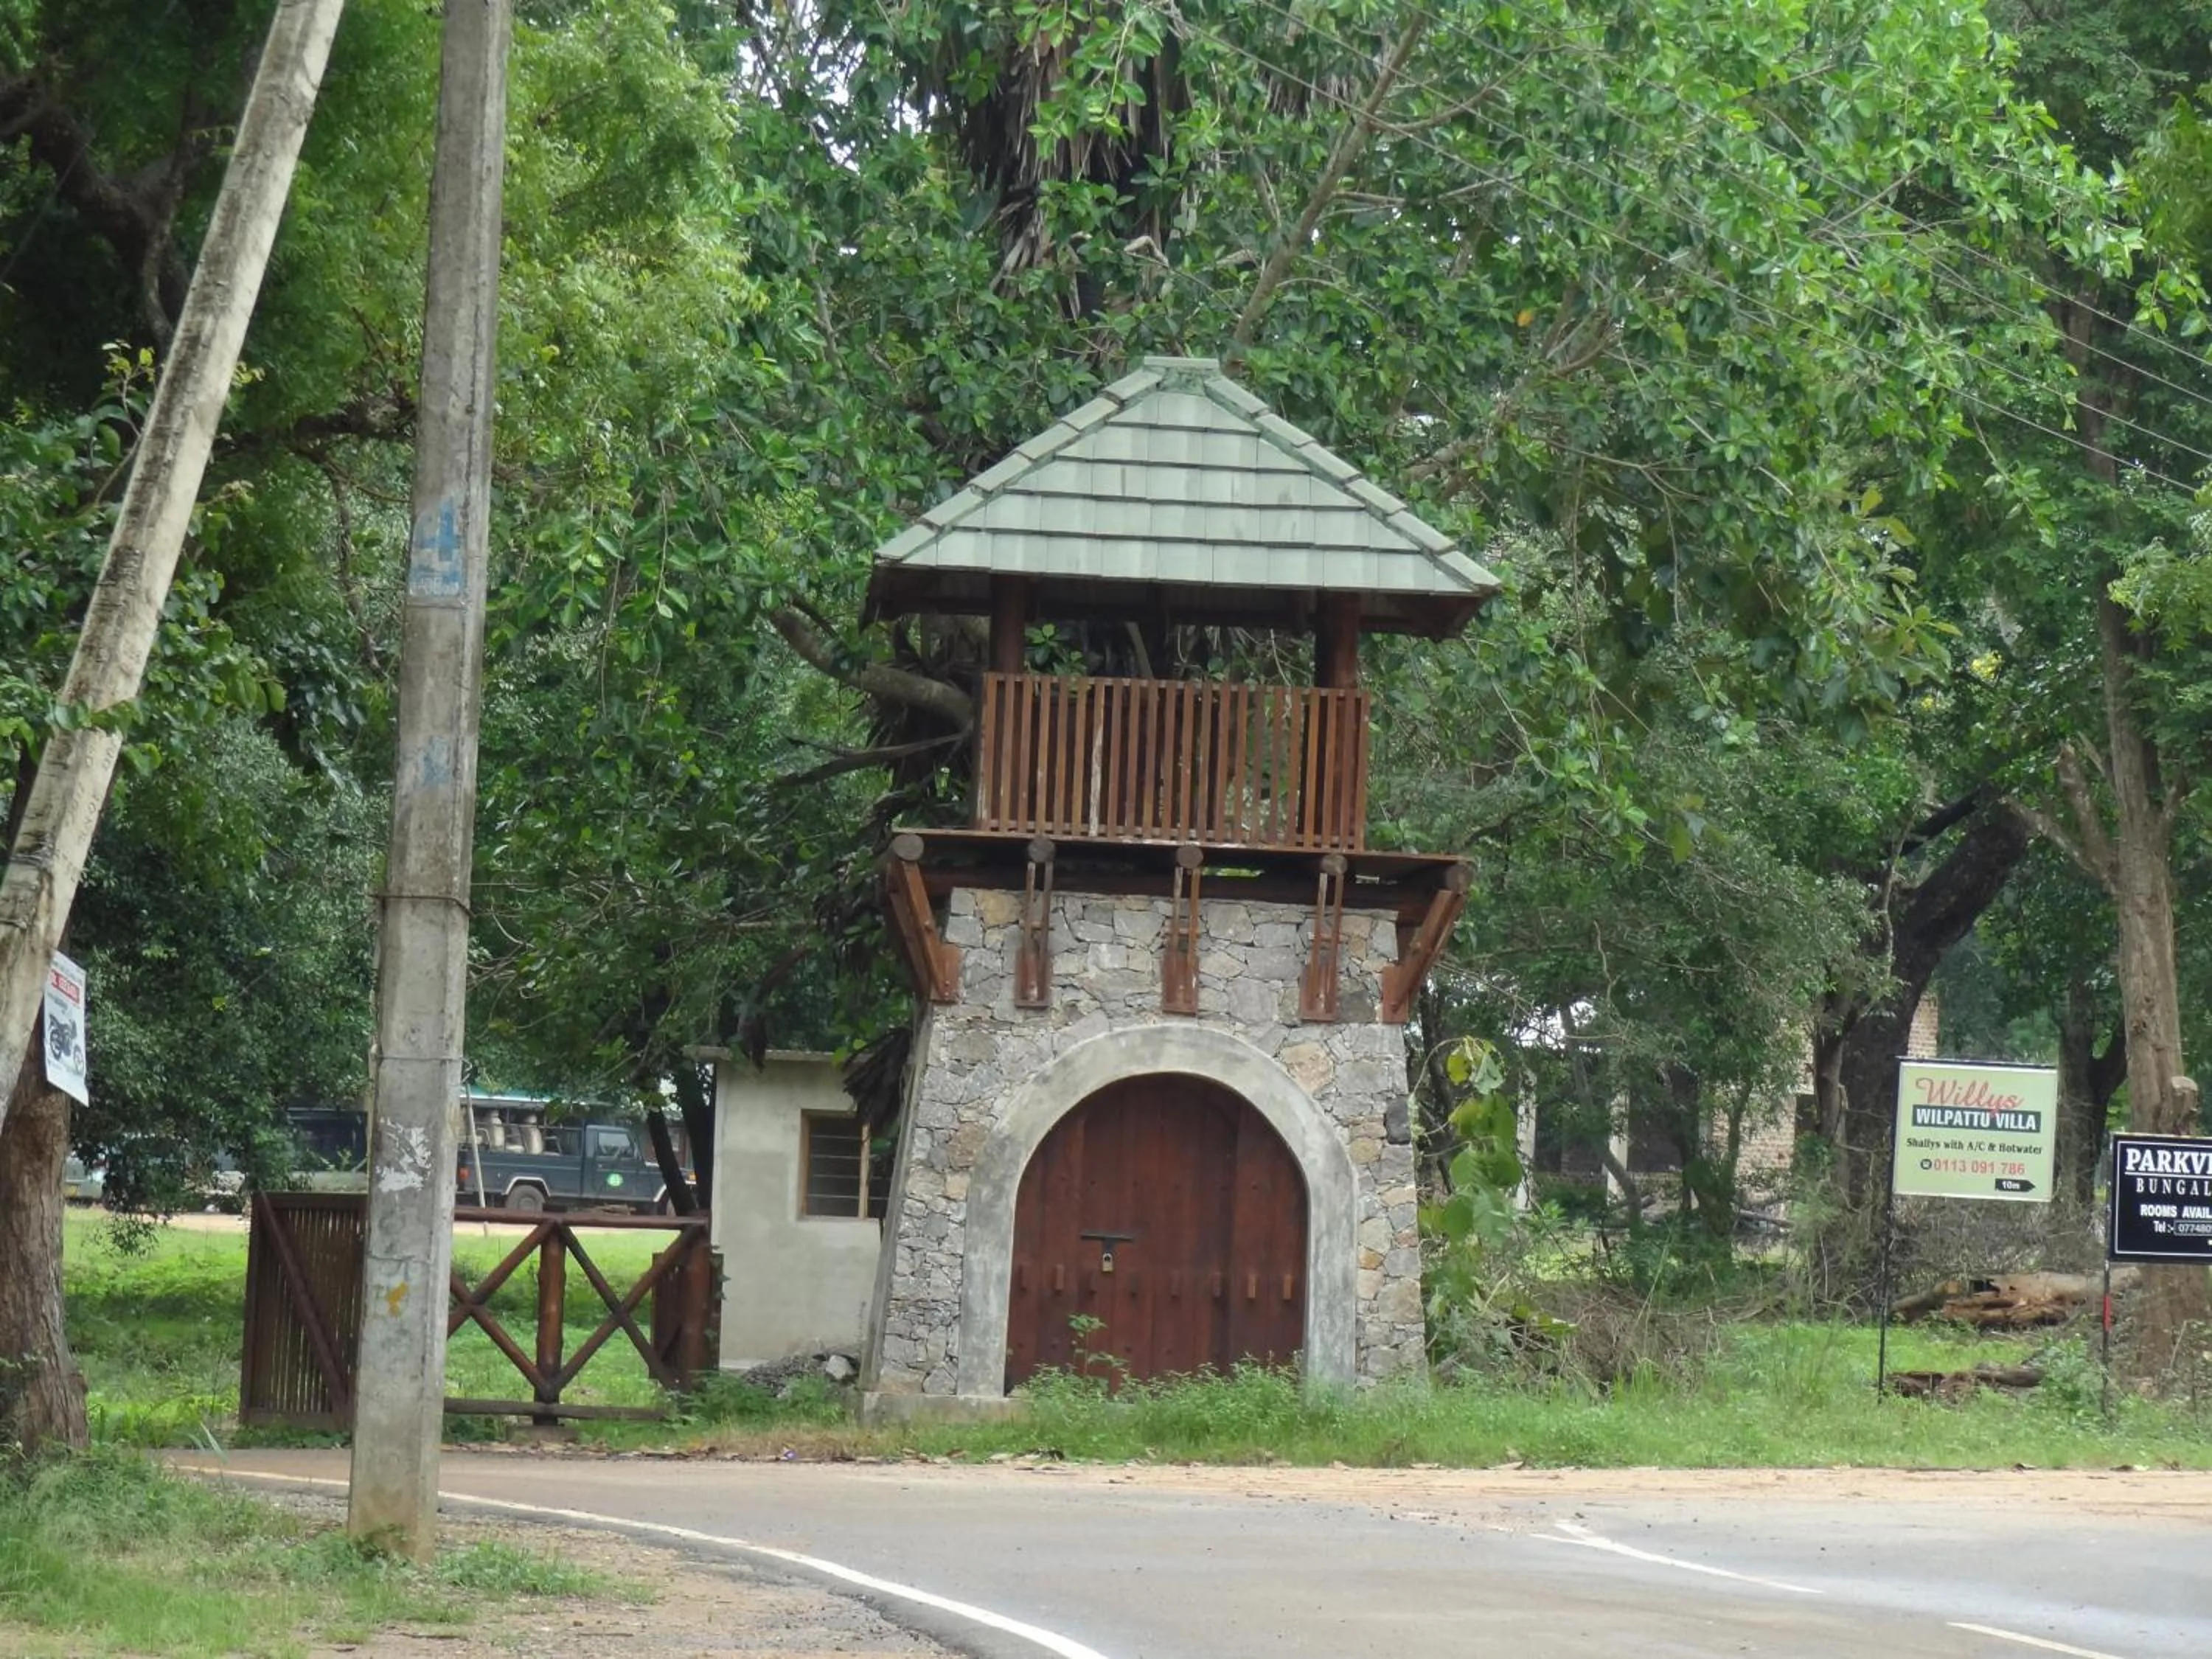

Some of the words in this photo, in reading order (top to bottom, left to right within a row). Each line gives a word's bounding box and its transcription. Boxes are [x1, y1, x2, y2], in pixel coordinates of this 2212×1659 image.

[1916, 1077, 2025, 1116] Willys
[1916, 1108, 1990, 1128] WILPATTU
[1995, 1113, 2037, 1130] VILLA
[1943, 1139, 1964, 1150] with
[1967, 1141, 1984, 1152] A/C
[1988, 1142, 1996, 1152] &
[1999, 1143, 2042, 1155] Hotwater
[1934, 1158, 1966, 1173] 0113
[1971, 1160, 1994, 1175] 091
[2000, 1161, 2025, 1176] 786
[2002, 1180, 2020, 1190] 10m
[2136, 1178, 2211, 1197] BUNGAL
[2140, 1204, 2177, 1218] ROOMS
